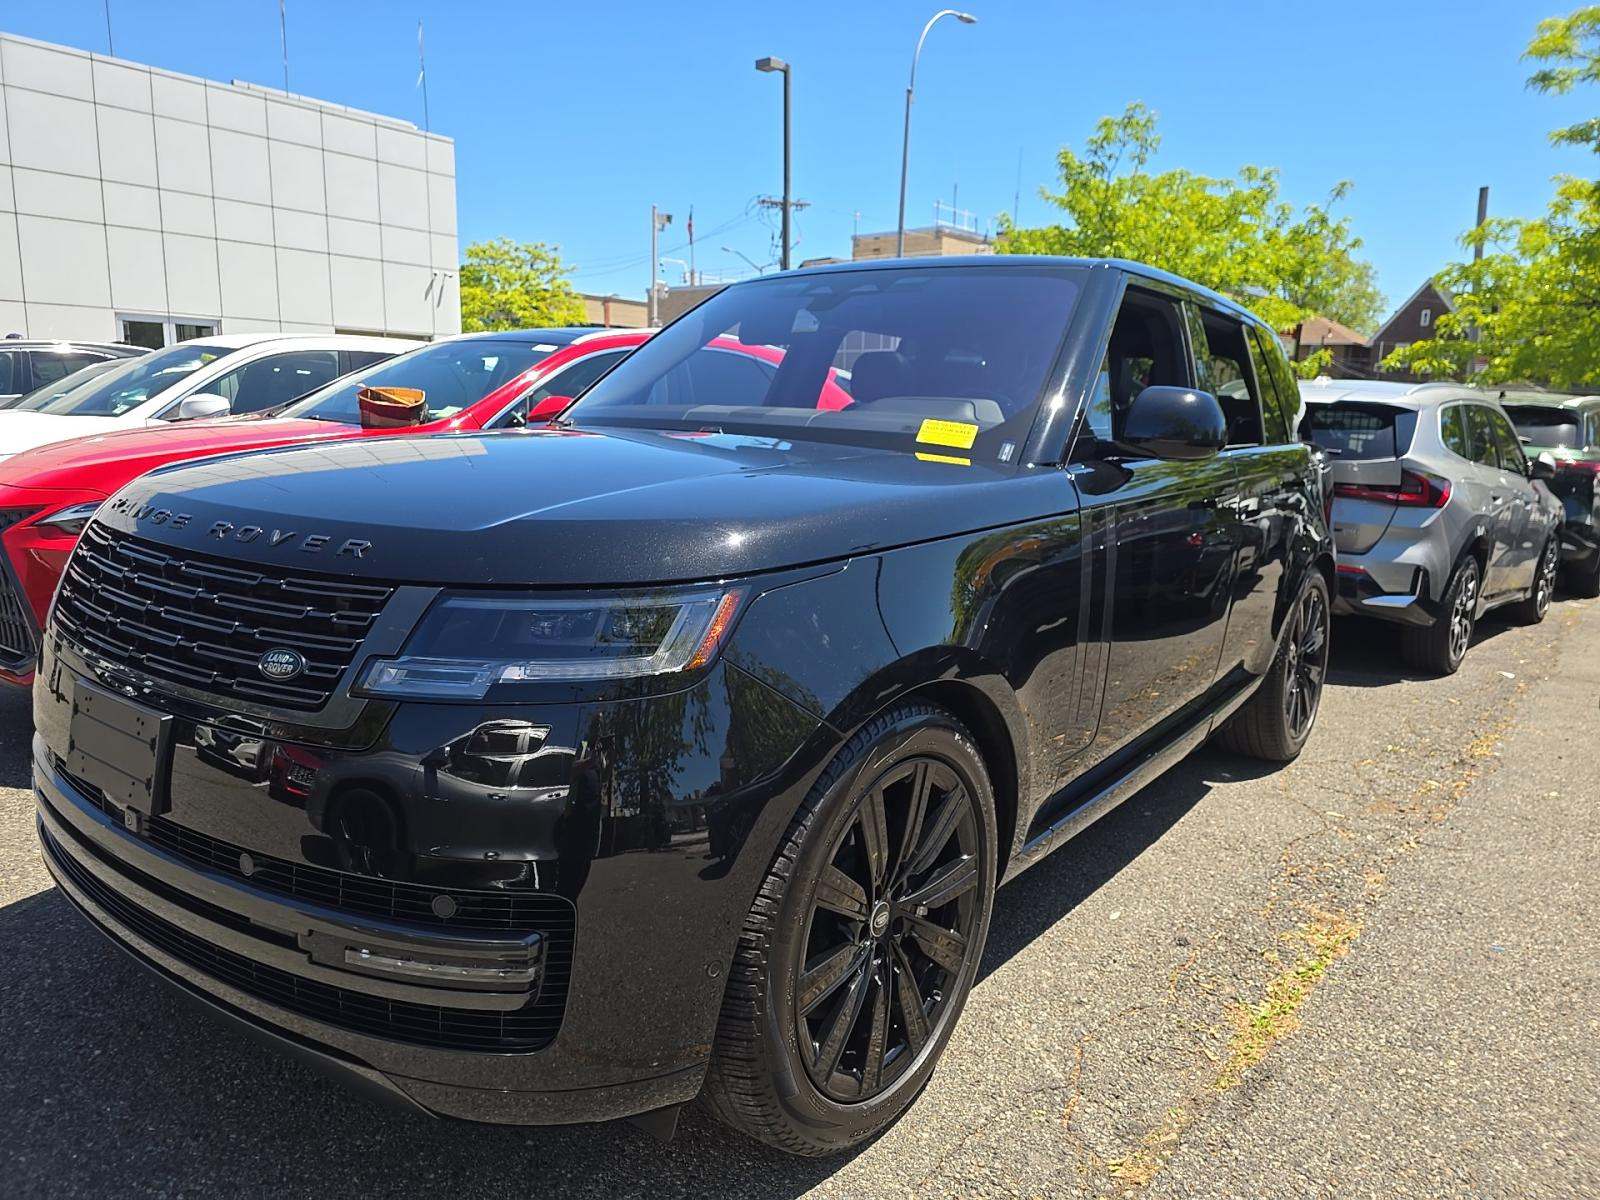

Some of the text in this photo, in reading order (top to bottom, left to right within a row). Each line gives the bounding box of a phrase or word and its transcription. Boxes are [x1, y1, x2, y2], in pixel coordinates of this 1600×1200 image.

[110, 498, 374, 559] RANGE ROVER
[267, 653, 290, 663] LAND
[267, 662, 294, 673] ROVER
